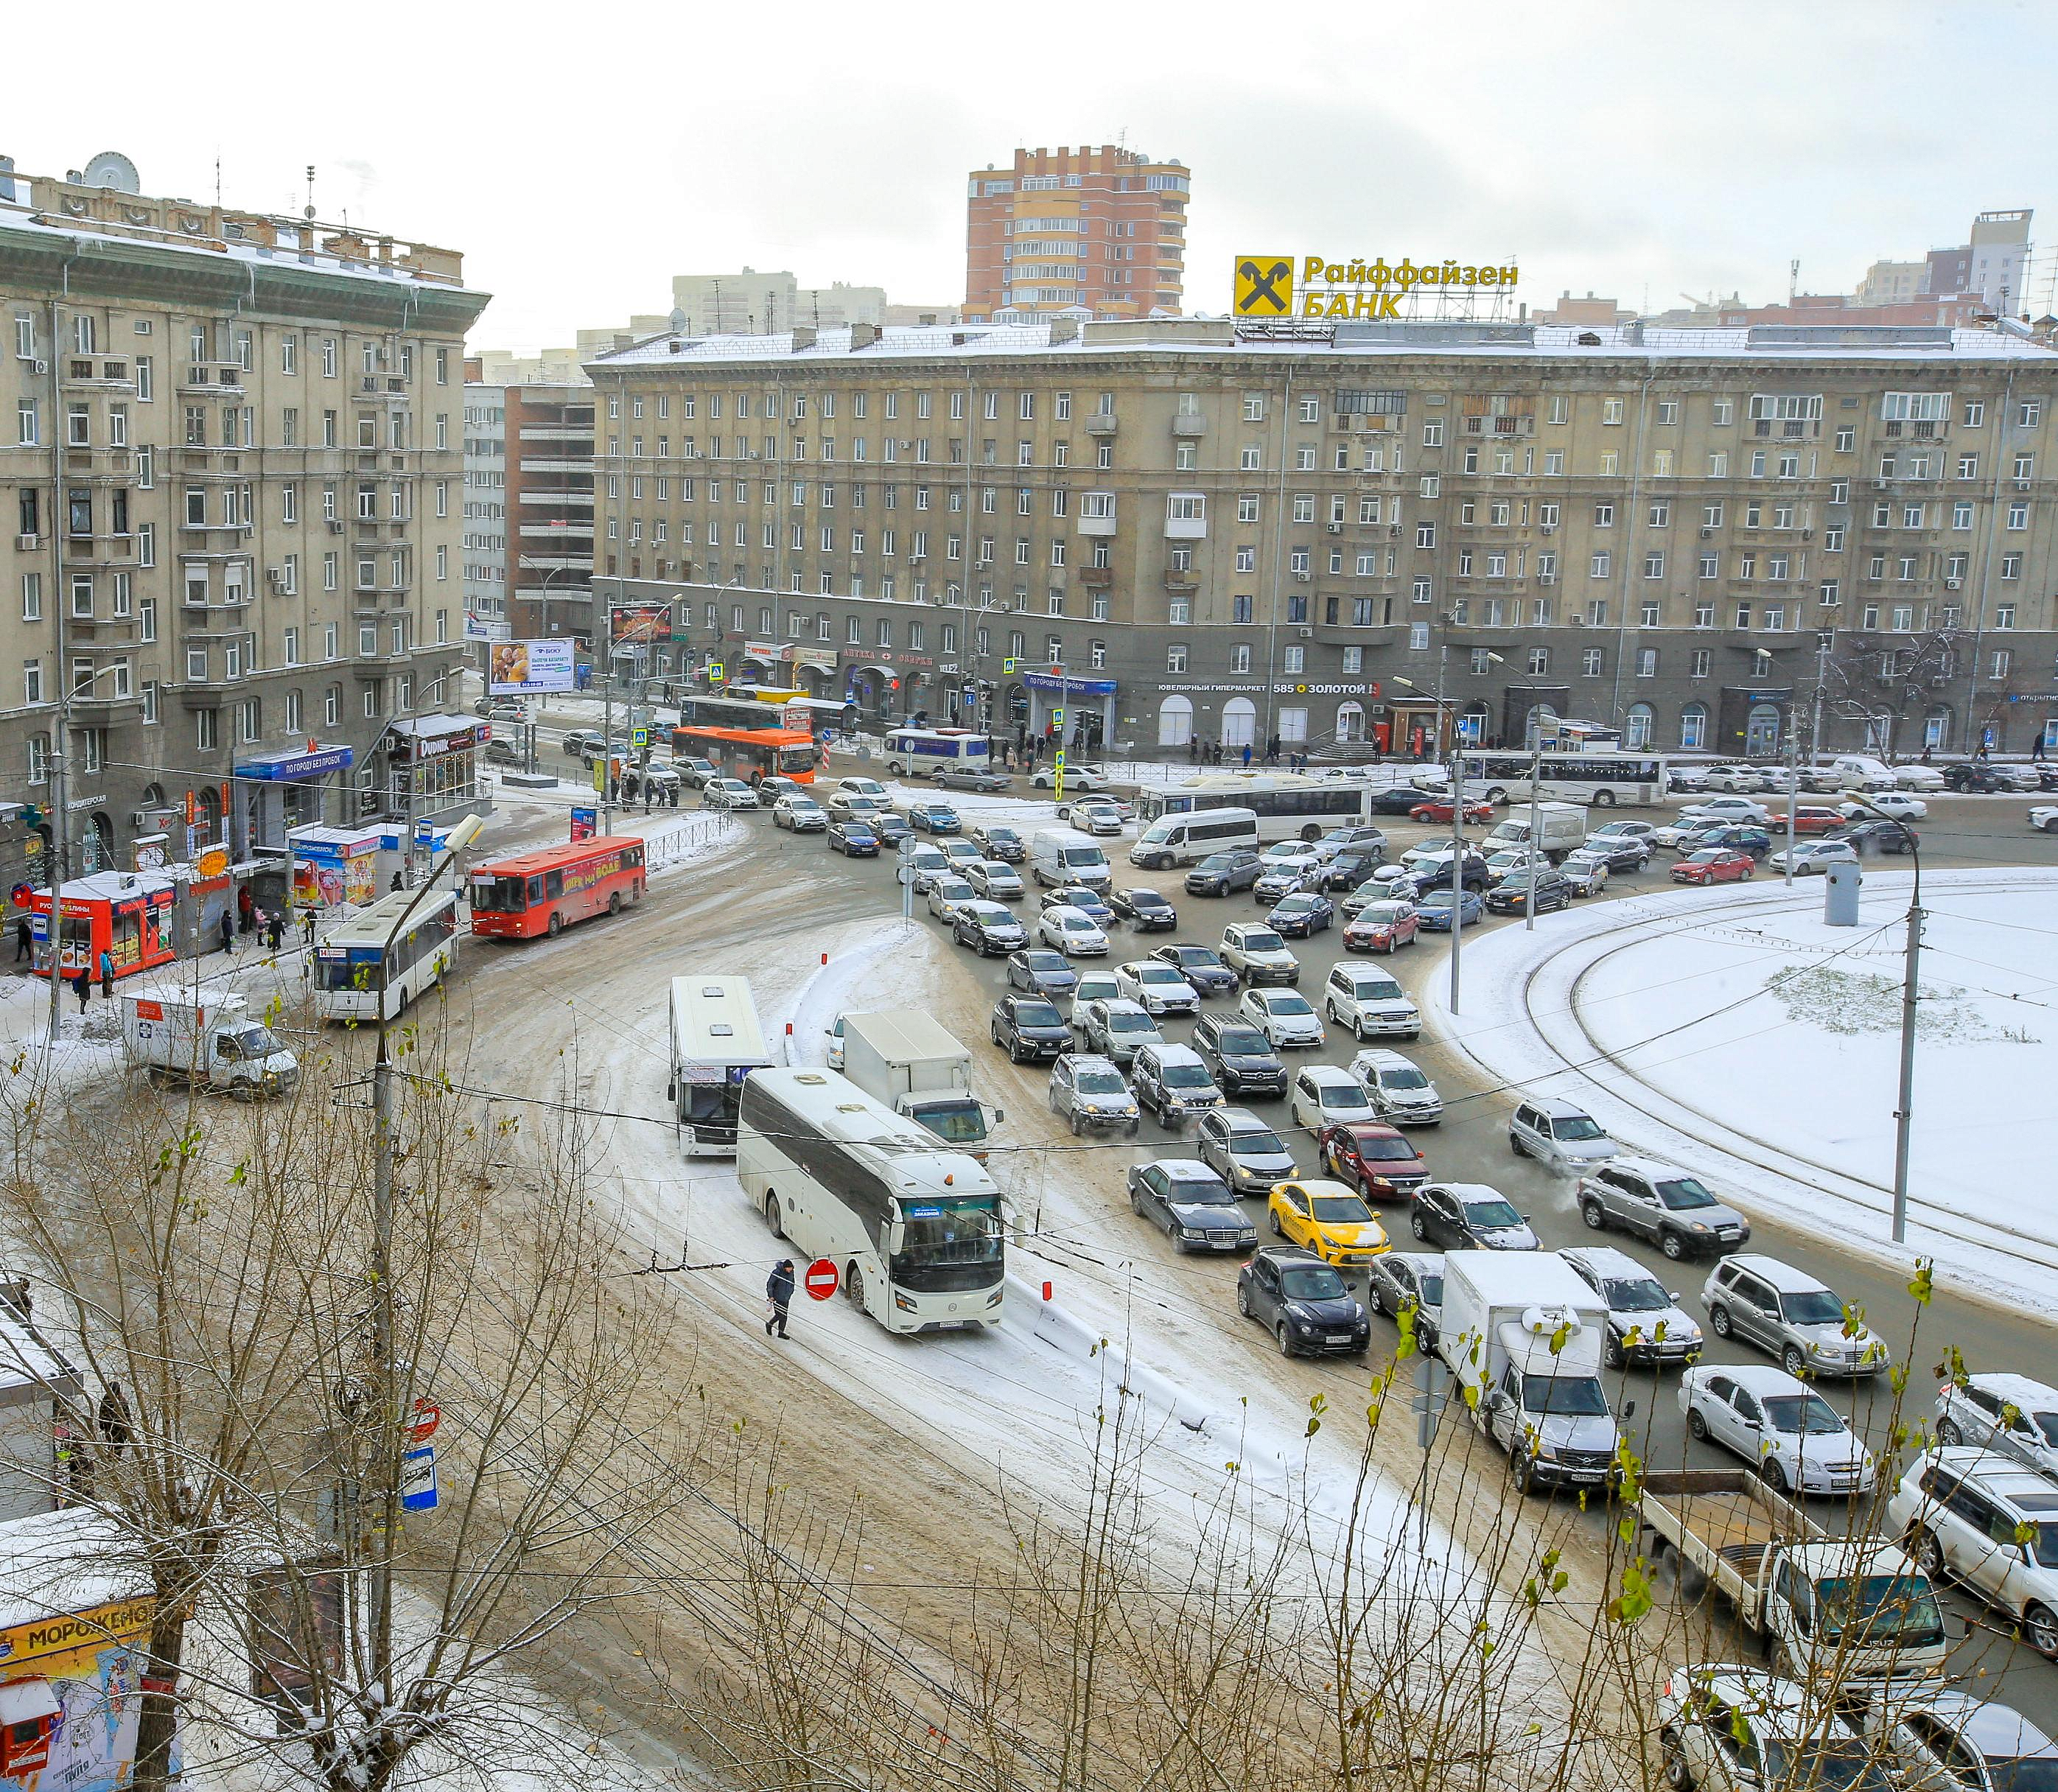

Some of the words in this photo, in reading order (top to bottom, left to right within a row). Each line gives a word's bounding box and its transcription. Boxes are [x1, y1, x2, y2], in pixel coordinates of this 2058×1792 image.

[1304, 255, 1519, 290] Райффайзен
[1303, 292, 1404, 319] БАНК
[1037, 678, 1056, 687] ГОРОДУ
[1273, 684, 1295, 694] 585
[1308, 683, 1365, 694] ЗОЛОТОЙ
[286, 764, 294, 774] ПО
[294, 760, 312, 771] ГОРОДУ
[312, 759, 322, 768] БЕЗ
[322, 755, 341, 767] ПРОБОК
[67, 794, 107, 810] КОНДИТЕРСКАЯ
[28, 1605, 156, 1650] МОРОЖЕНО
[1869, 1639, 1903, 1648] ISUZ
